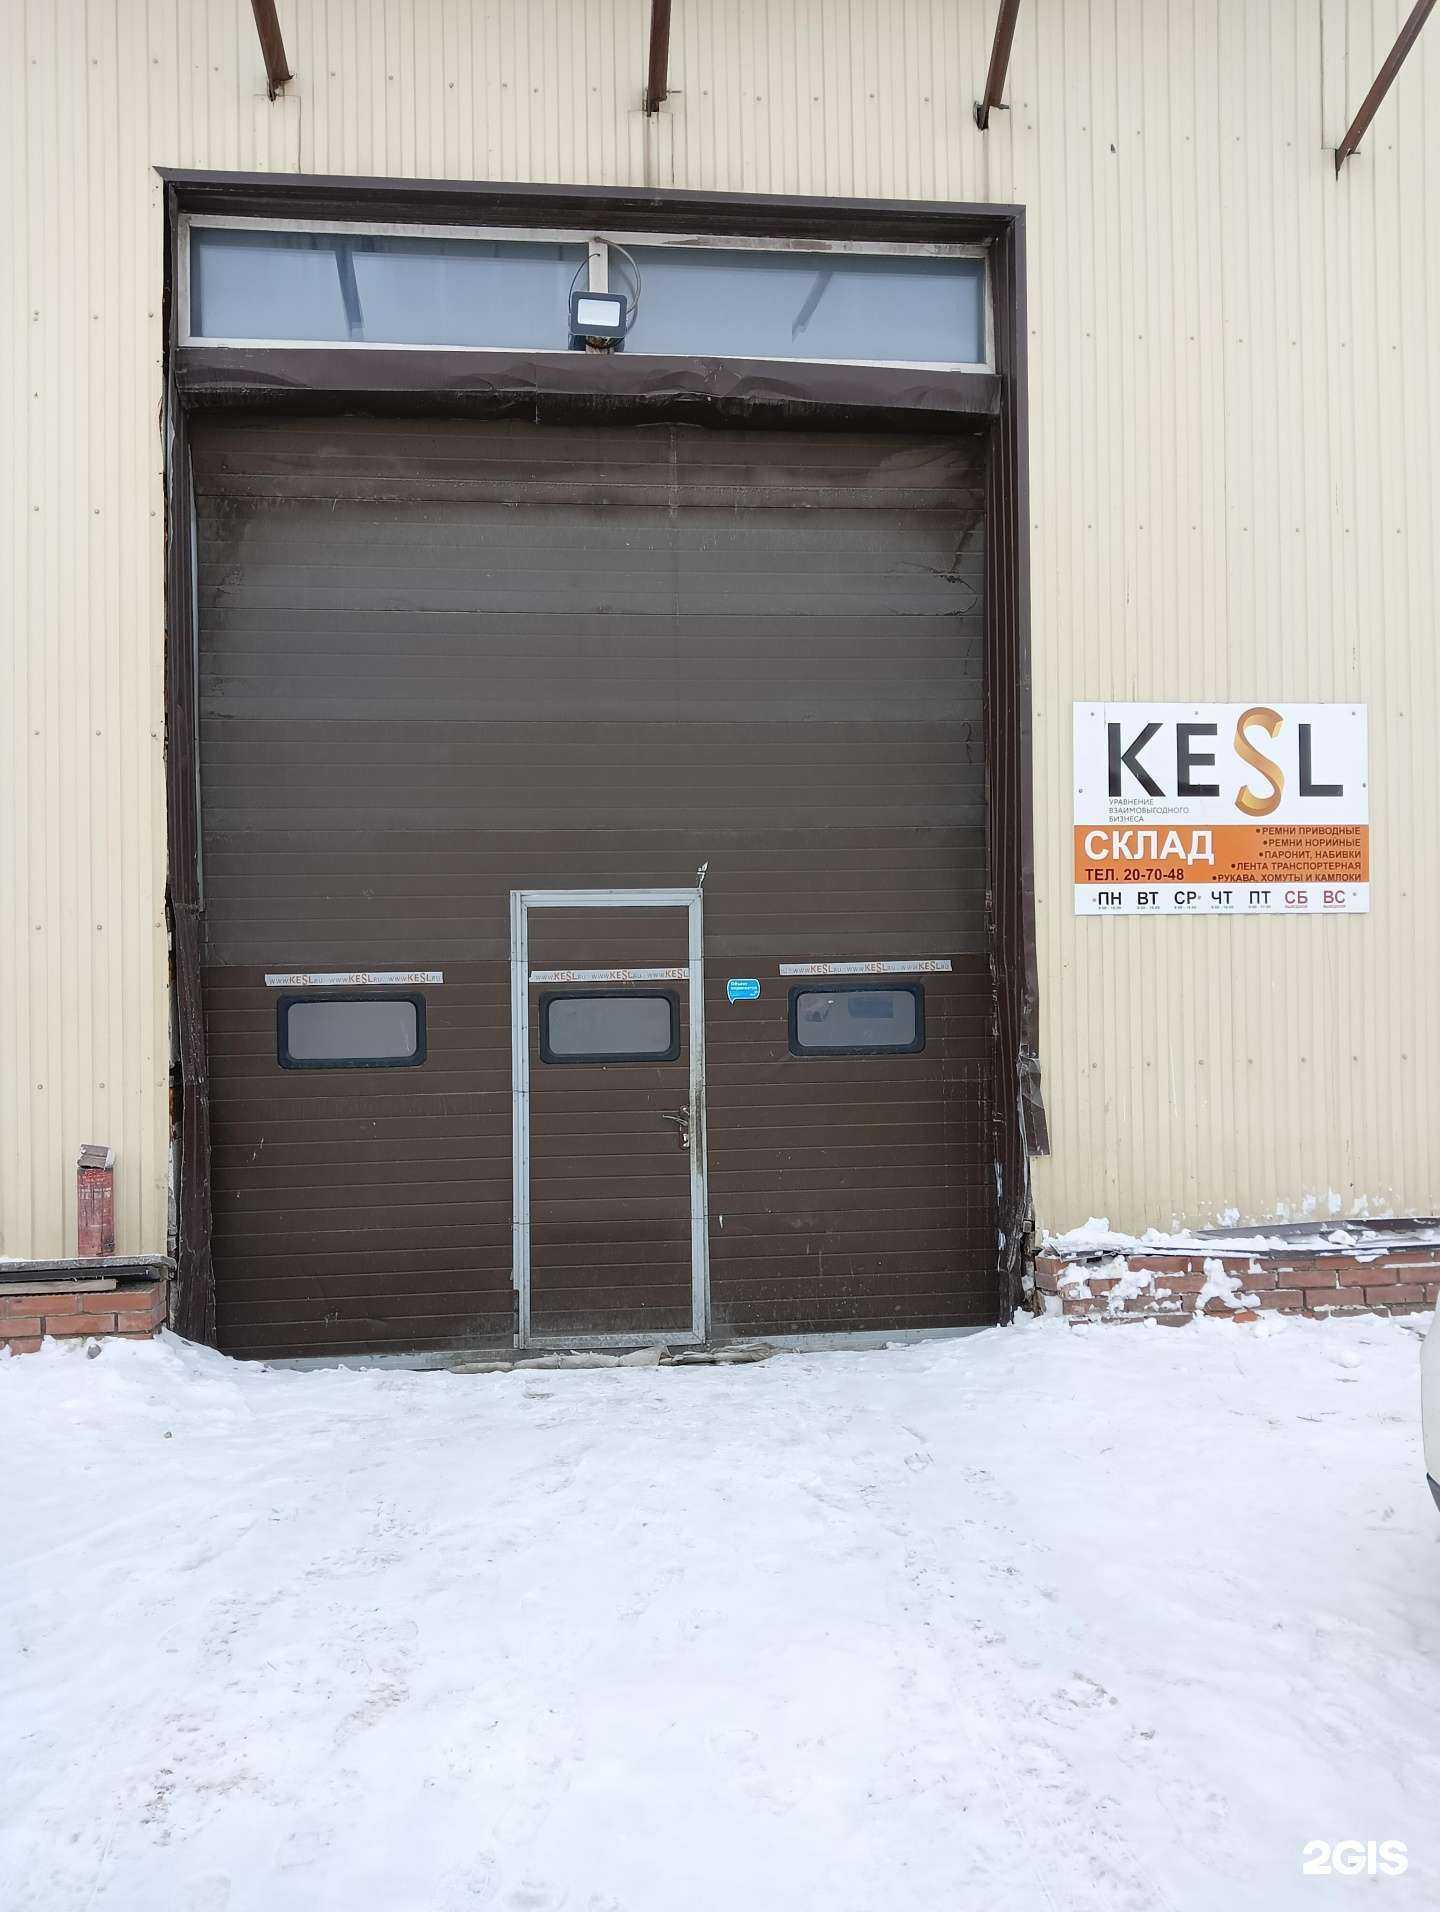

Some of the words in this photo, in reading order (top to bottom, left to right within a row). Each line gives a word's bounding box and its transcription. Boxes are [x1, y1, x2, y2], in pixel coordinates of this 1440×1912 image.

[1107, 706, 1344, 817] KESL
[1109, 798, 1154, 806] УРАВНЕНИЕ
[1109, 806, 1190, 815] ВЗАИМОВЫГОДНОГО
[1109, 815, 1145, 823] БИЗНЕСА
[1262, 826, 1296, 835] РЕМНИ
[1299, 826, 1361, 836] ПРИВОДНЫЕ
[1268, 838, 1303, 847] РЕМНИ
[1084, 829, 1215, 866] СКЛАД
[1315, 850, 1361, 859] НАБИВКИ
[1236, 862, 1269, 871] ЛЕНТА
[1271, 861, 1361, 870] ТРАНСПОРТЕРНАЯ
[1085, 868, 1119, 881] ТЕЛ.
[1123, 868, 1184, 881] 20-70-48
[1261, 873, 1303, 882] ХОМУТЫ
[1305, 873, 1313, 882] И
[1098, 891, 1122, 905] ПН
[1137, 891, 1159, 905] ВТ
[1174, 891, 1197, 904] СР
[1211, 890, 1233, 904] ЧТ
[1249, 890, 1271, 904] ПТ
[1285, 890, 1308, 904] СБ
[1323, 890, 1346, 904] ВС
